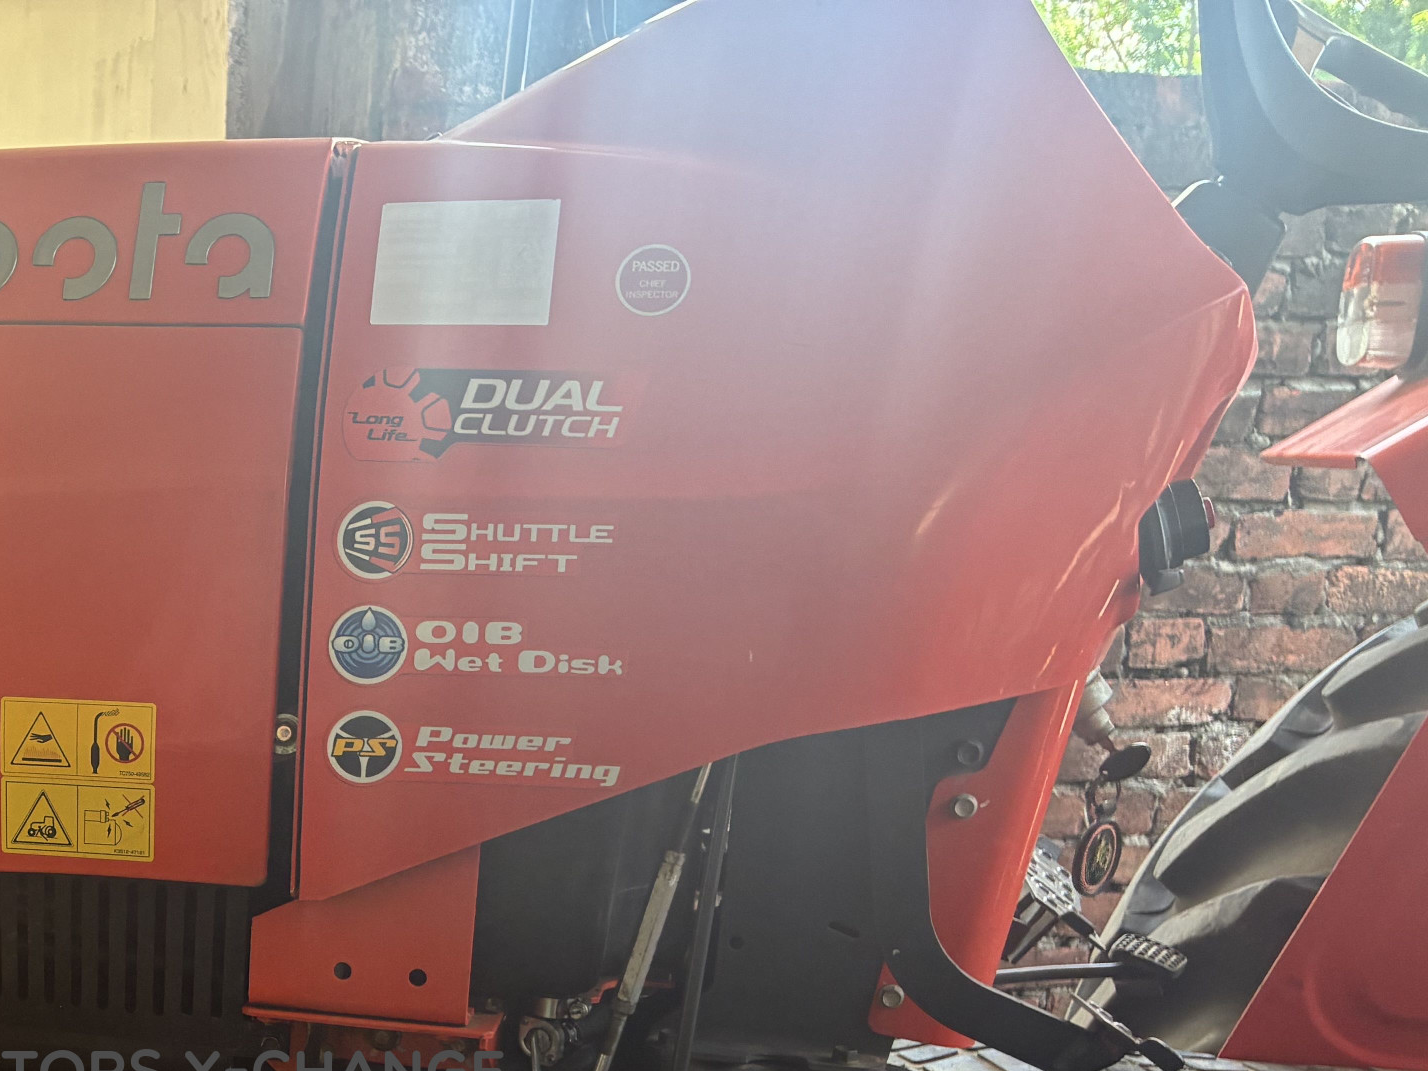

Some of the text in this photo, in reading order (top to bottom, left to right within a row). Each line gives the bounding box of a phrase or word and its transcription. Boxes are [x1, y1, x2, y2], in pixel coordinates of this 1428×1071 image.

[632, 260, 680, 272] PASSED
[625, 290, 678, 299] INSPECTOR
[639, 279, 667, 288] CHIEF
[460, 378, 623, 412] DUAL
[348, 411, 404, 427] Long
[454, 413, 620, 438] CLUTCH
[367, 428, 418, 442] Life
[421, 513, 615, 544] SHUTTLE
[419, 543, 578, 574] SHIFT
[415, 620, 523, 645] OIB
[413, 649, 623, 676] Wet Disk
[332, 738, 397, 757] PS
[415, 725, 572, 753] Power
[404, 752, 621, 787] Steering
